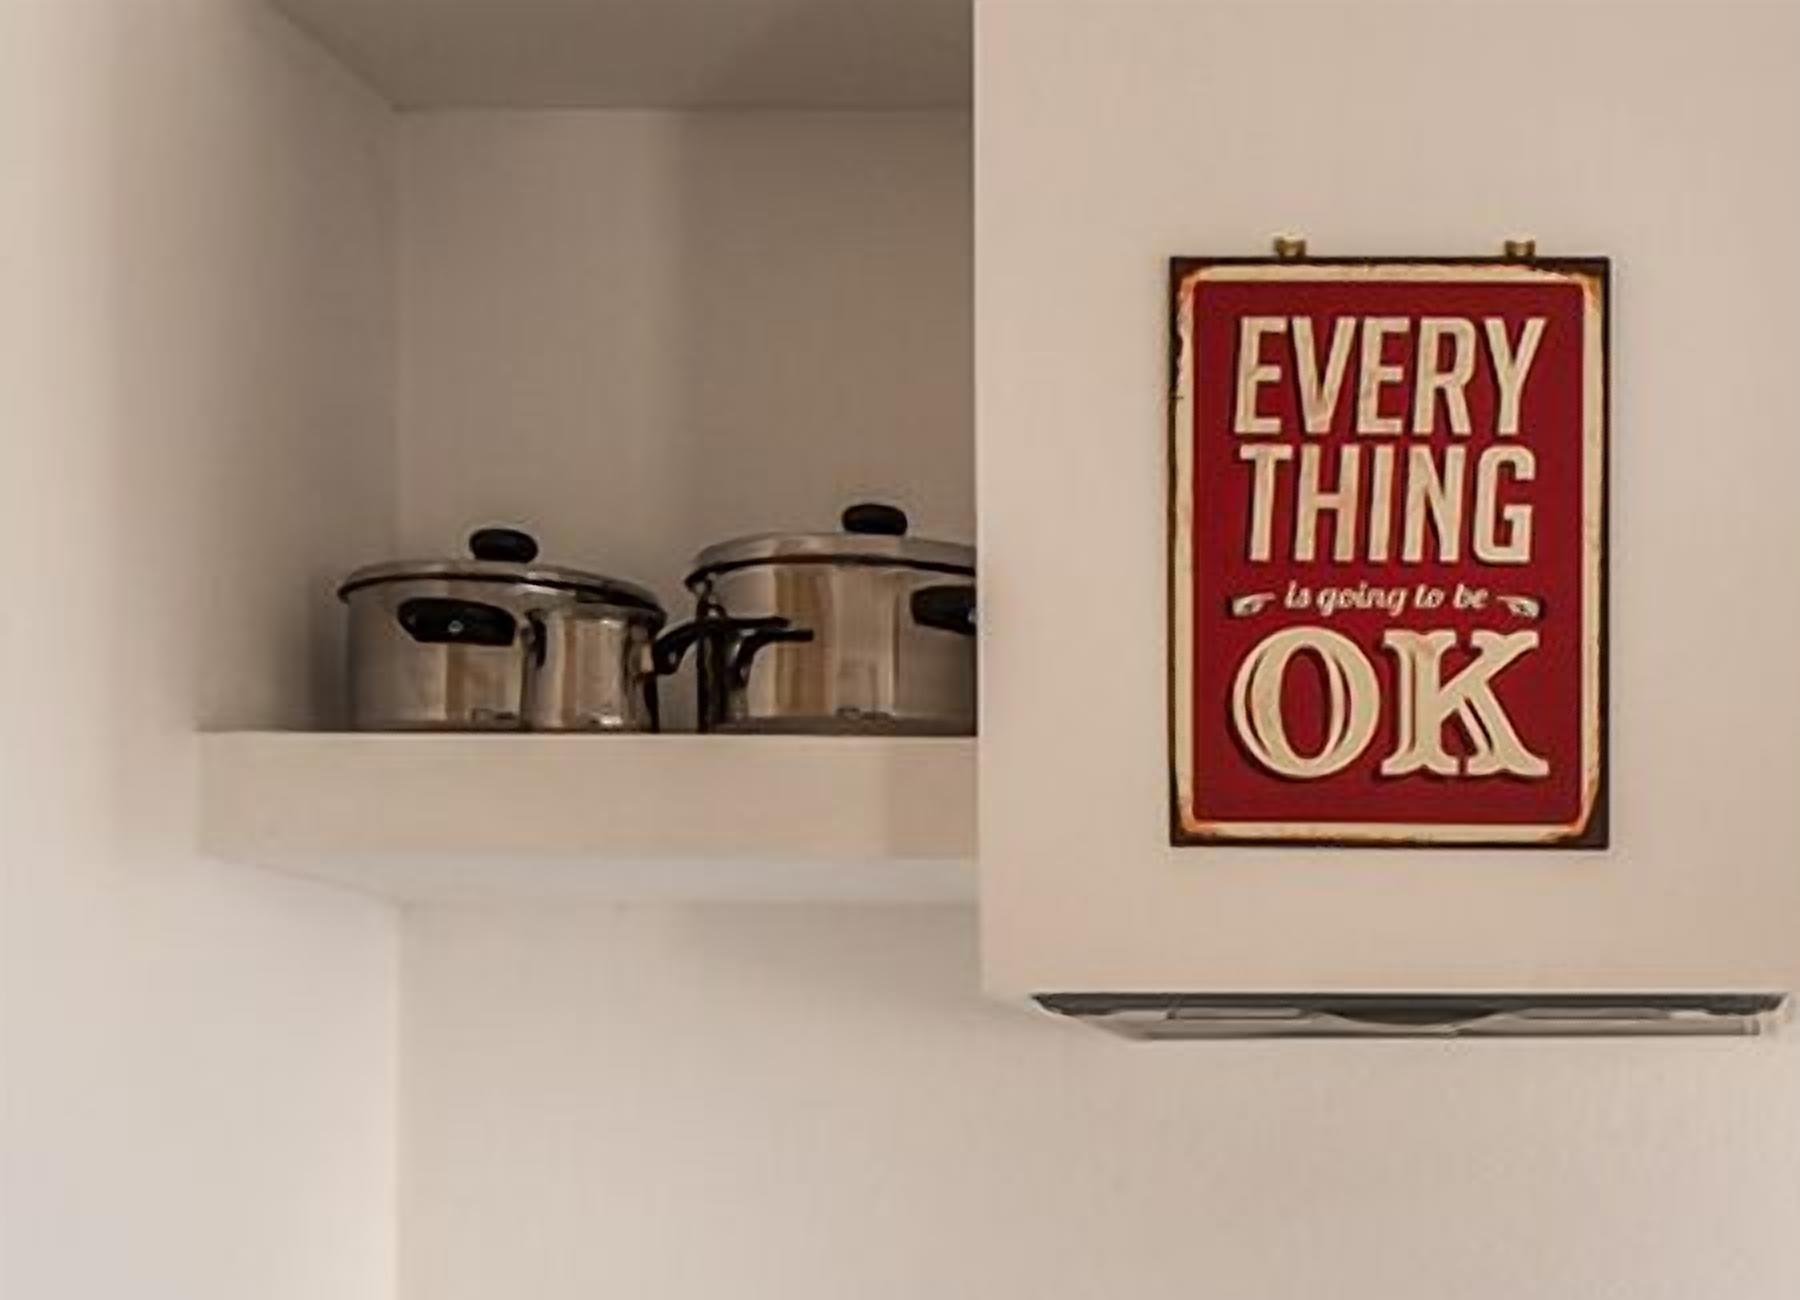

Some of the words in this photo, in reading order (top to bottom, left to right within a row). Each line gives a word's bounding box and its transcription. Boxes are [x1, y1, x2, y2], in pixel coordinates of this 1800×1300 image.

[1233, 315, 1546, 436] EVERY
[1239, 444, 1536, 565] THING
[1284, 580, 1311, 609] is
[1316, 580, 1407, 617] going
[1415, 583, 1445, 609] to
[1453, 583, 1488, 609] be
[1232, 625, 1551, 779] OK
